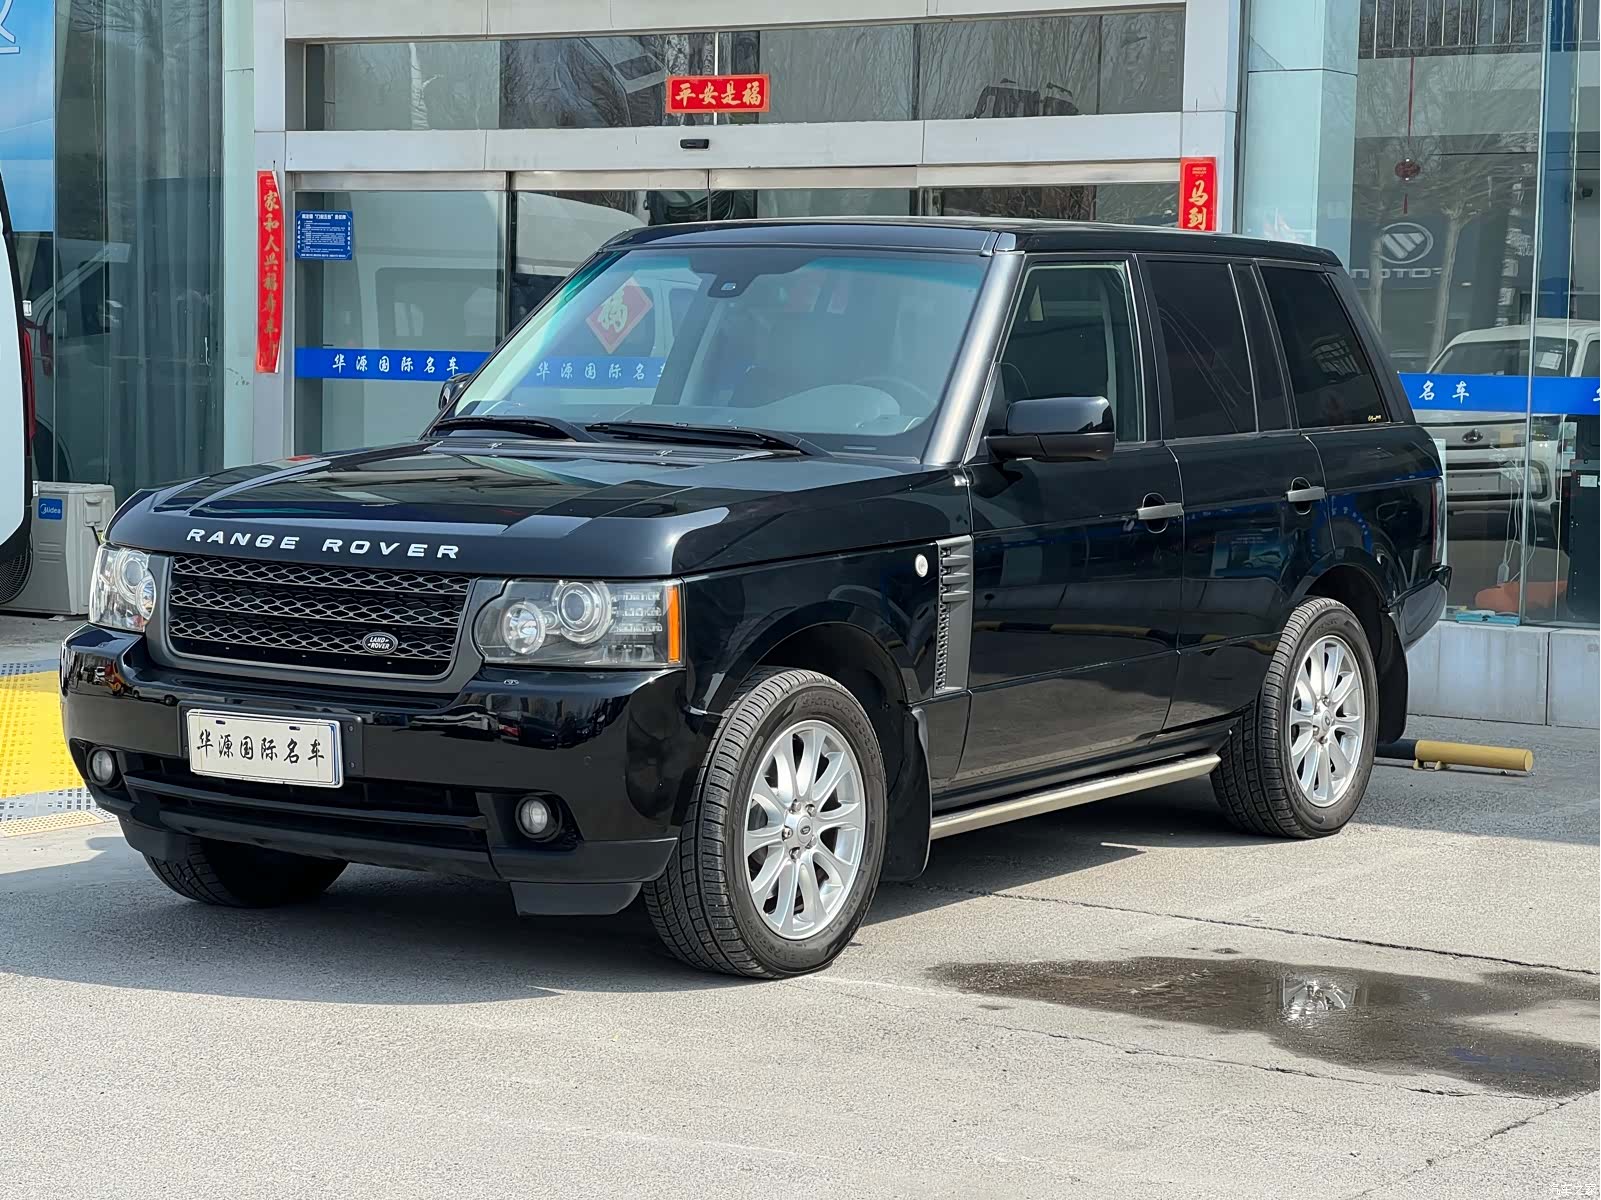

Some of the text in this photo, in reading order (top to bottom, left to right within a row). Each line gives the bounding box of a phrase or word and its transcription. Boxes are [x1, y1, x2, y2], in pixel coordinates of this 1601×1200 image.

[675, 81, 761, 107] 平安是福
[1187, 180, 1208, 230] 马到
[332, 353, 459, 376] 华源国际名车
[1418, 380, 1470, 404] 名车
[186, 528, 459, 559] RANGE ROVER
[370, 642, 390, 650] ROVER
[196, 728, 325, 768] 华源国际名车
